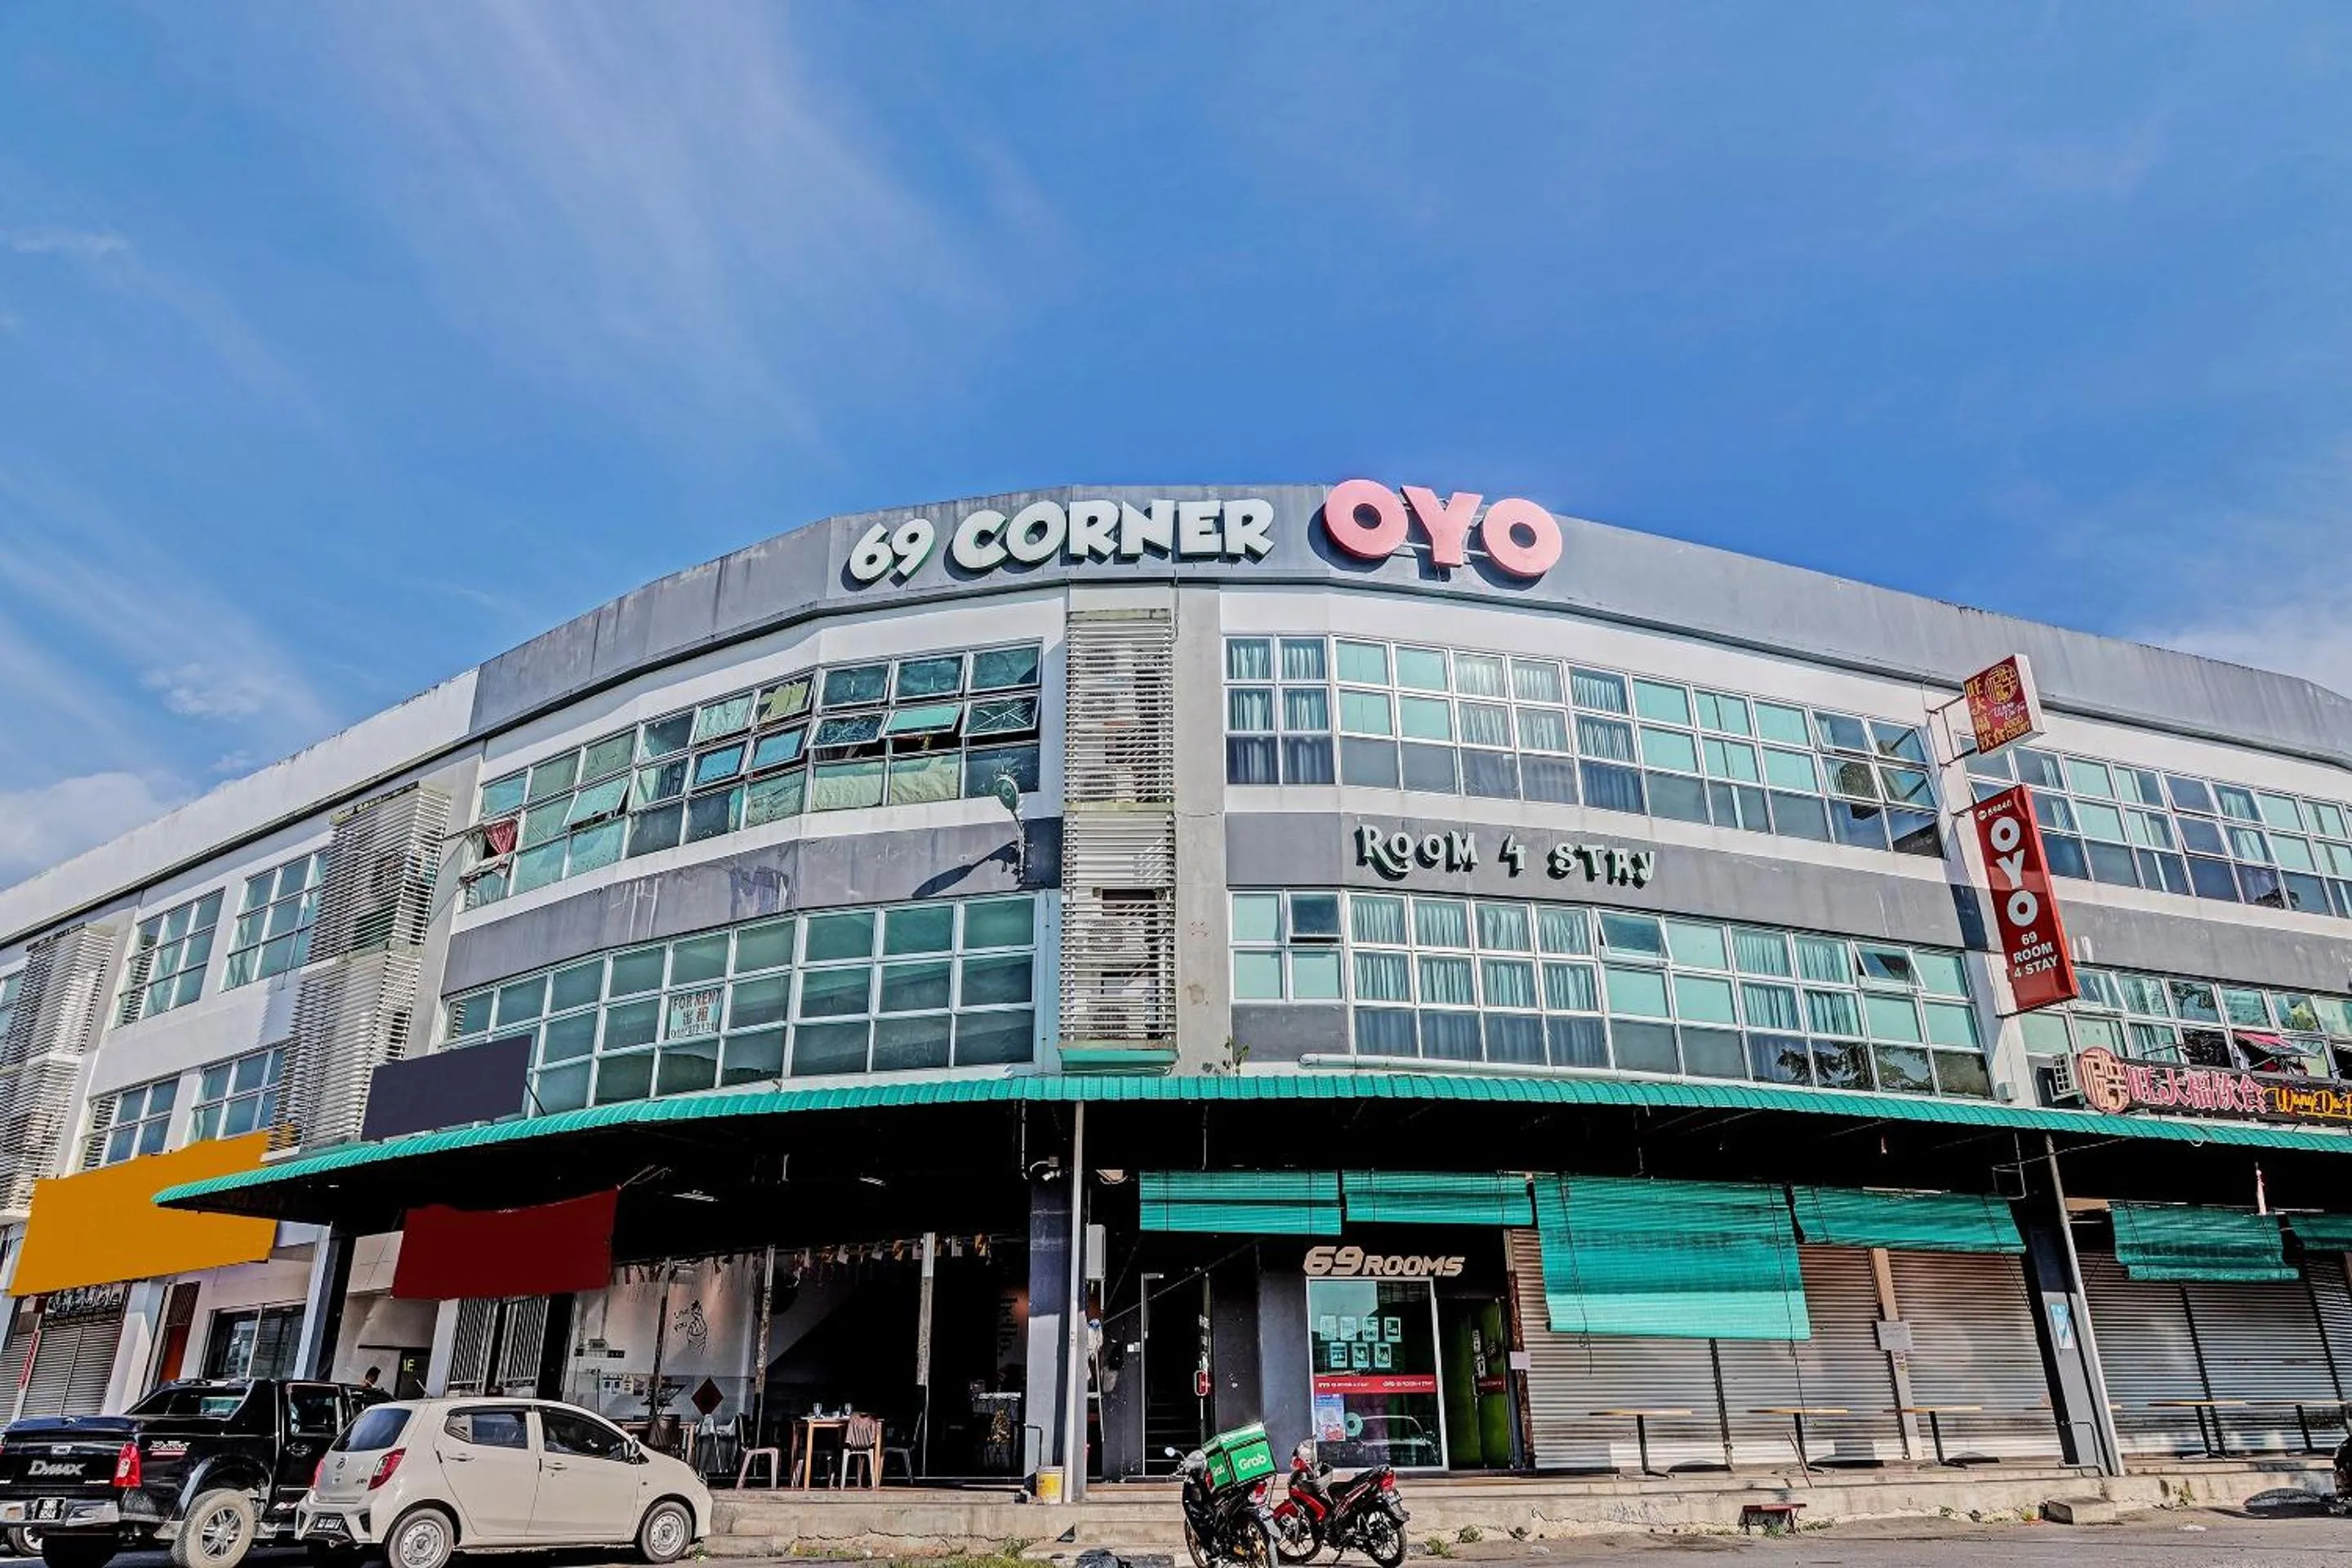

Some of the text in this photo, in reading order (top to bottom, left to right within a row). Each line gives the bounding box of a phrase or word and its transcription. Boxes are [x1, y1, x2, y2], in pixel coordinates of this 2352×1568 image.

[849, 499, 1276, 581] 69 CORNER
[1323, 479, 1562, 576] OYO
[1358, 824, 1655, 883] ROOM 4 STAY
[1991, 817, 2038, 927] OYO
[2021, 931, 2038, 946] 69
[2013, 942, 2053, 964] ROOM
[2014, 955, 2058, 978] 4 STAY
[673, 988, 722, 1010] FOR RENT
[1303, 1246, 1465, 1276] 69 ROOMS
[1239, 1454, 1267, 1470] Grab
